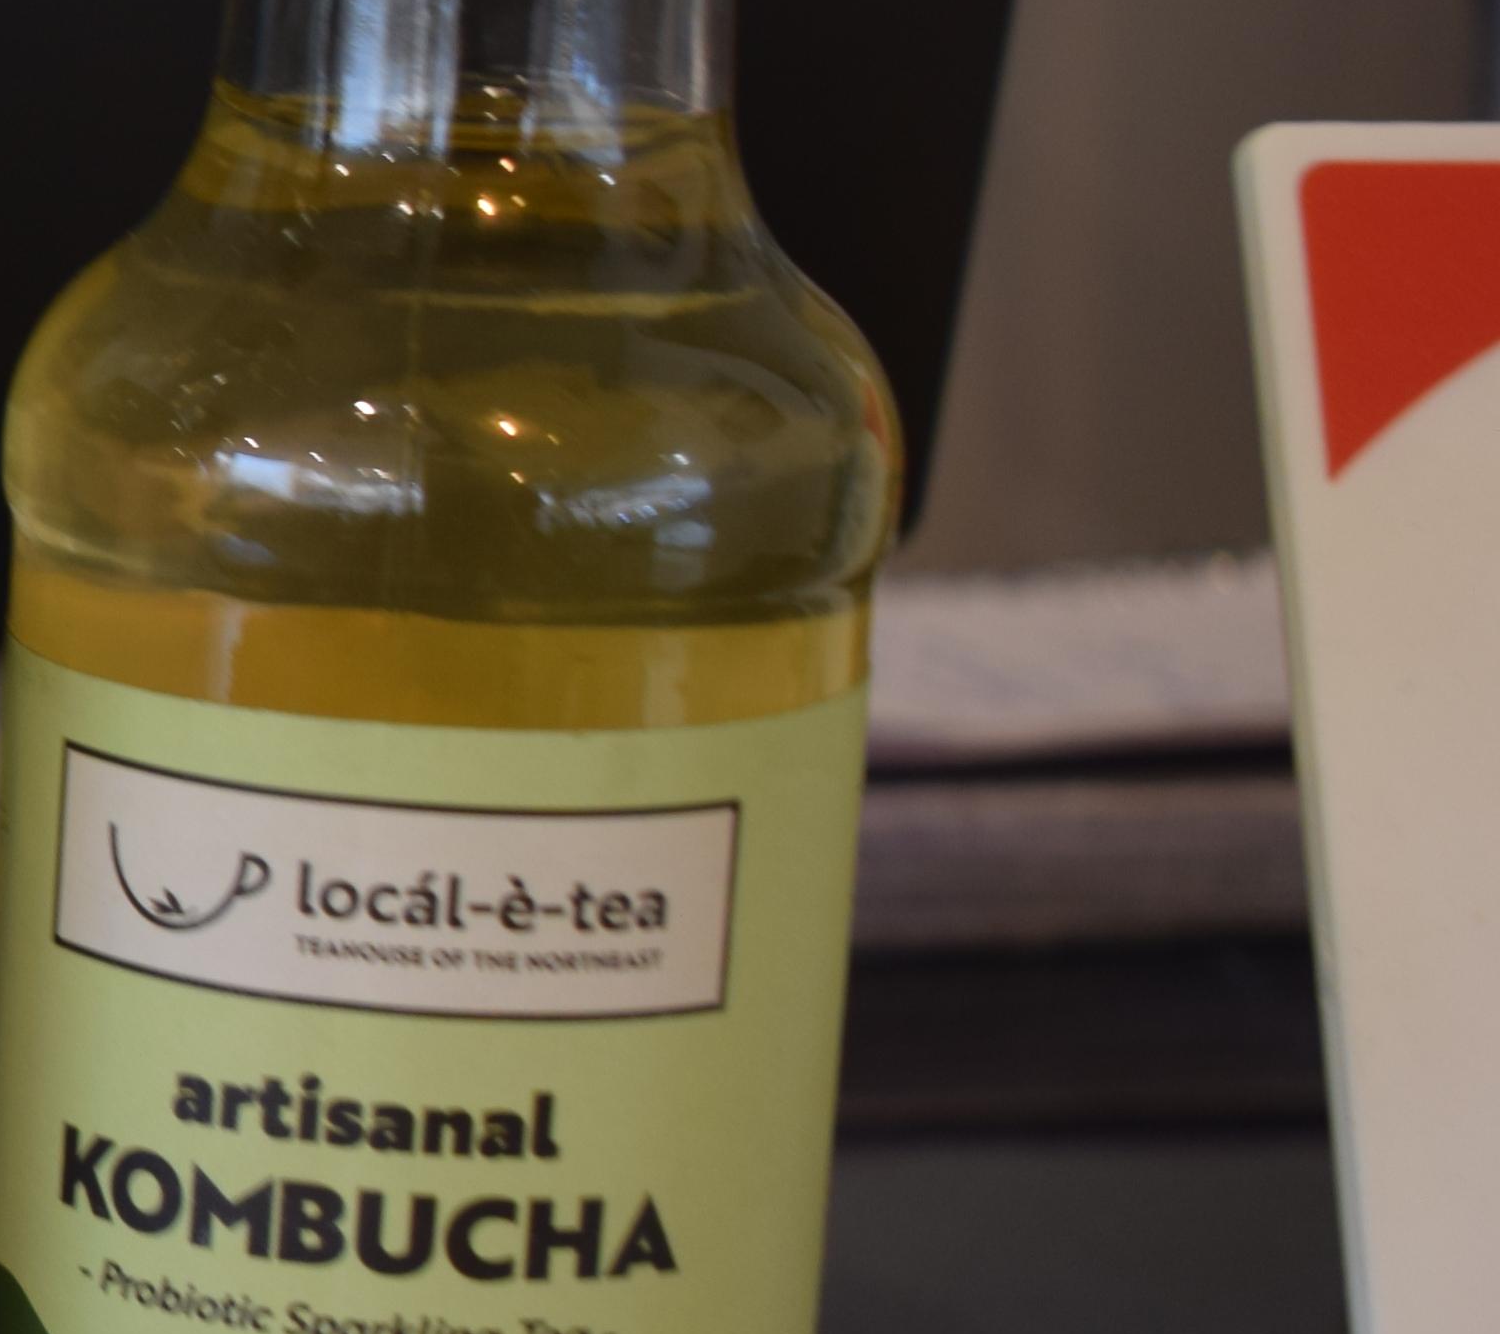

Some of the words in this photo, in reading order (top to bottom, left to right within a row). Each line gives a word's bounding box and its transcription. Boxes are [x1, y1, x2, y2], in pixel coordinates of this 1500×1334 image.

[295, 861, 667, 931] locál-è-tea
[295, 936, 424, 969] TEAHOUSE
[432, 947, 466, 969] OF
[473, 949, 518, 970] THE
[524, 949, 662, 974] NORTHEAST
[174, 1072, 559, 1159] artisanal
[59, 1122, 679, 1281] KOMBUCHA
[98, 1260, 272, 1334] Probiotic
